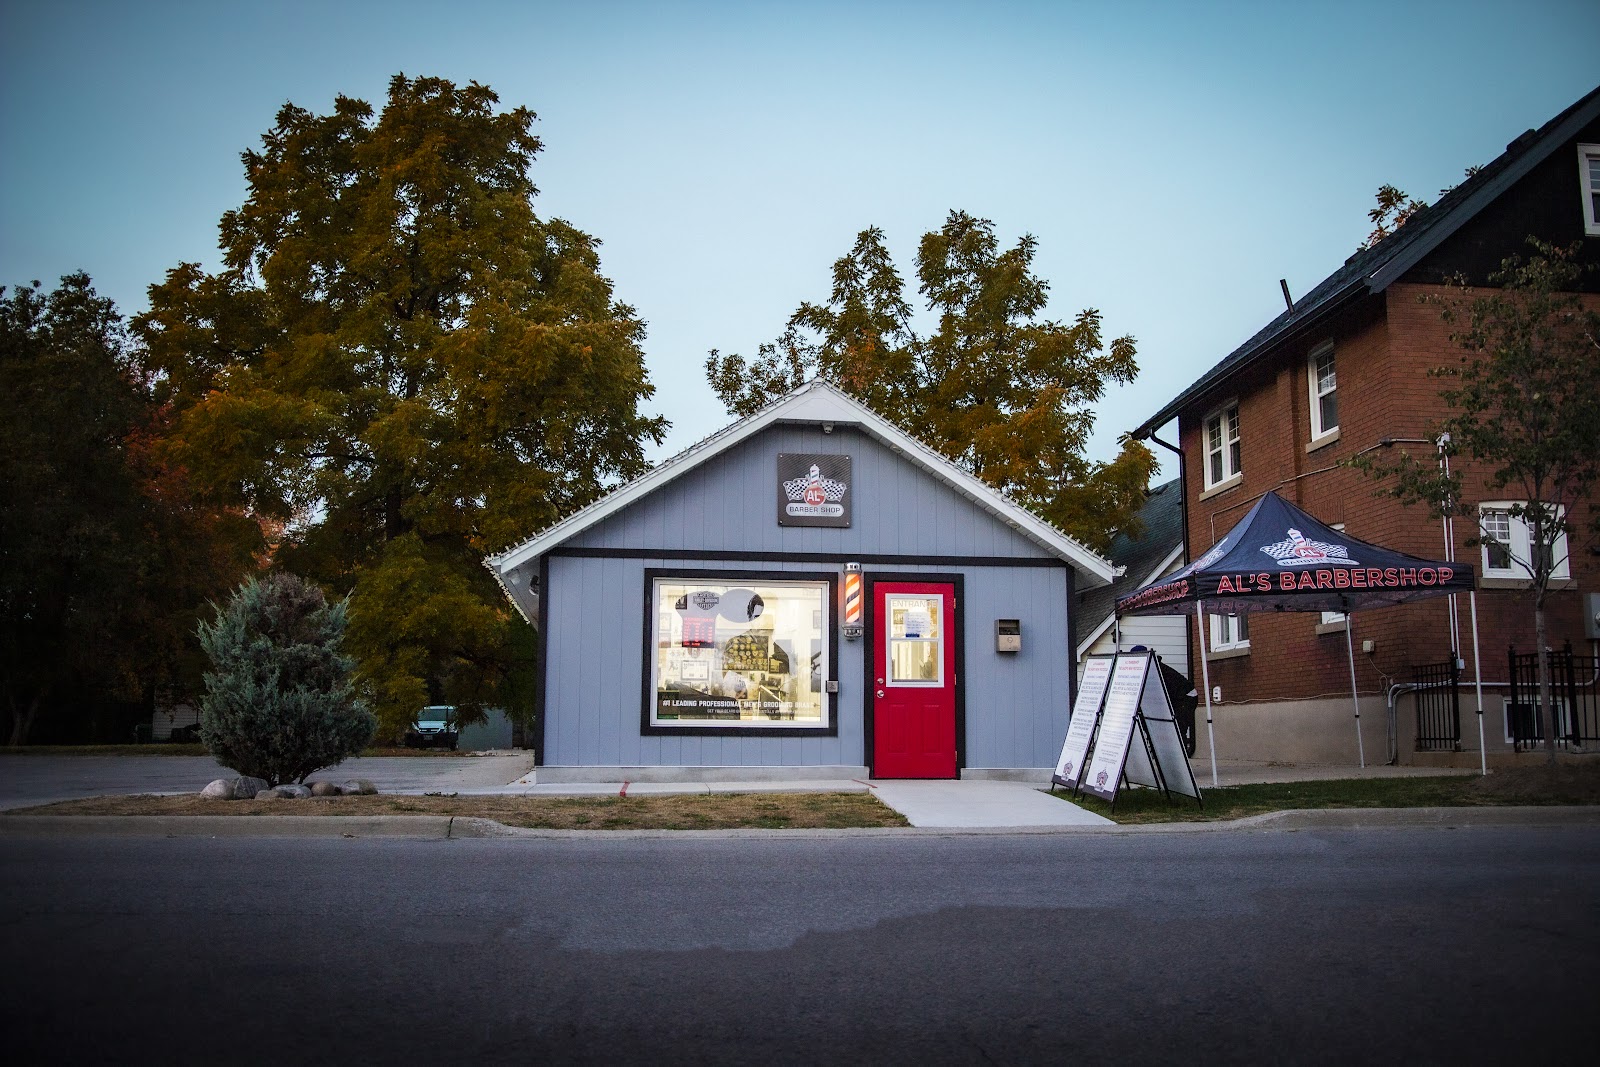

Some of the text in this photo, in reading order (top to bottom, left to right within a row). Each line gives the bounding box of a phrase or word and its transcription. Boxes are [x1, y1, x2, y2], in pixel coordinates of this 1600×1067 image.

[807, 490, 821, 502] AL
[1299, 548, 1321, 557] AL
[1217, 567, 1455, 594] AL'S BARBERSHOP
